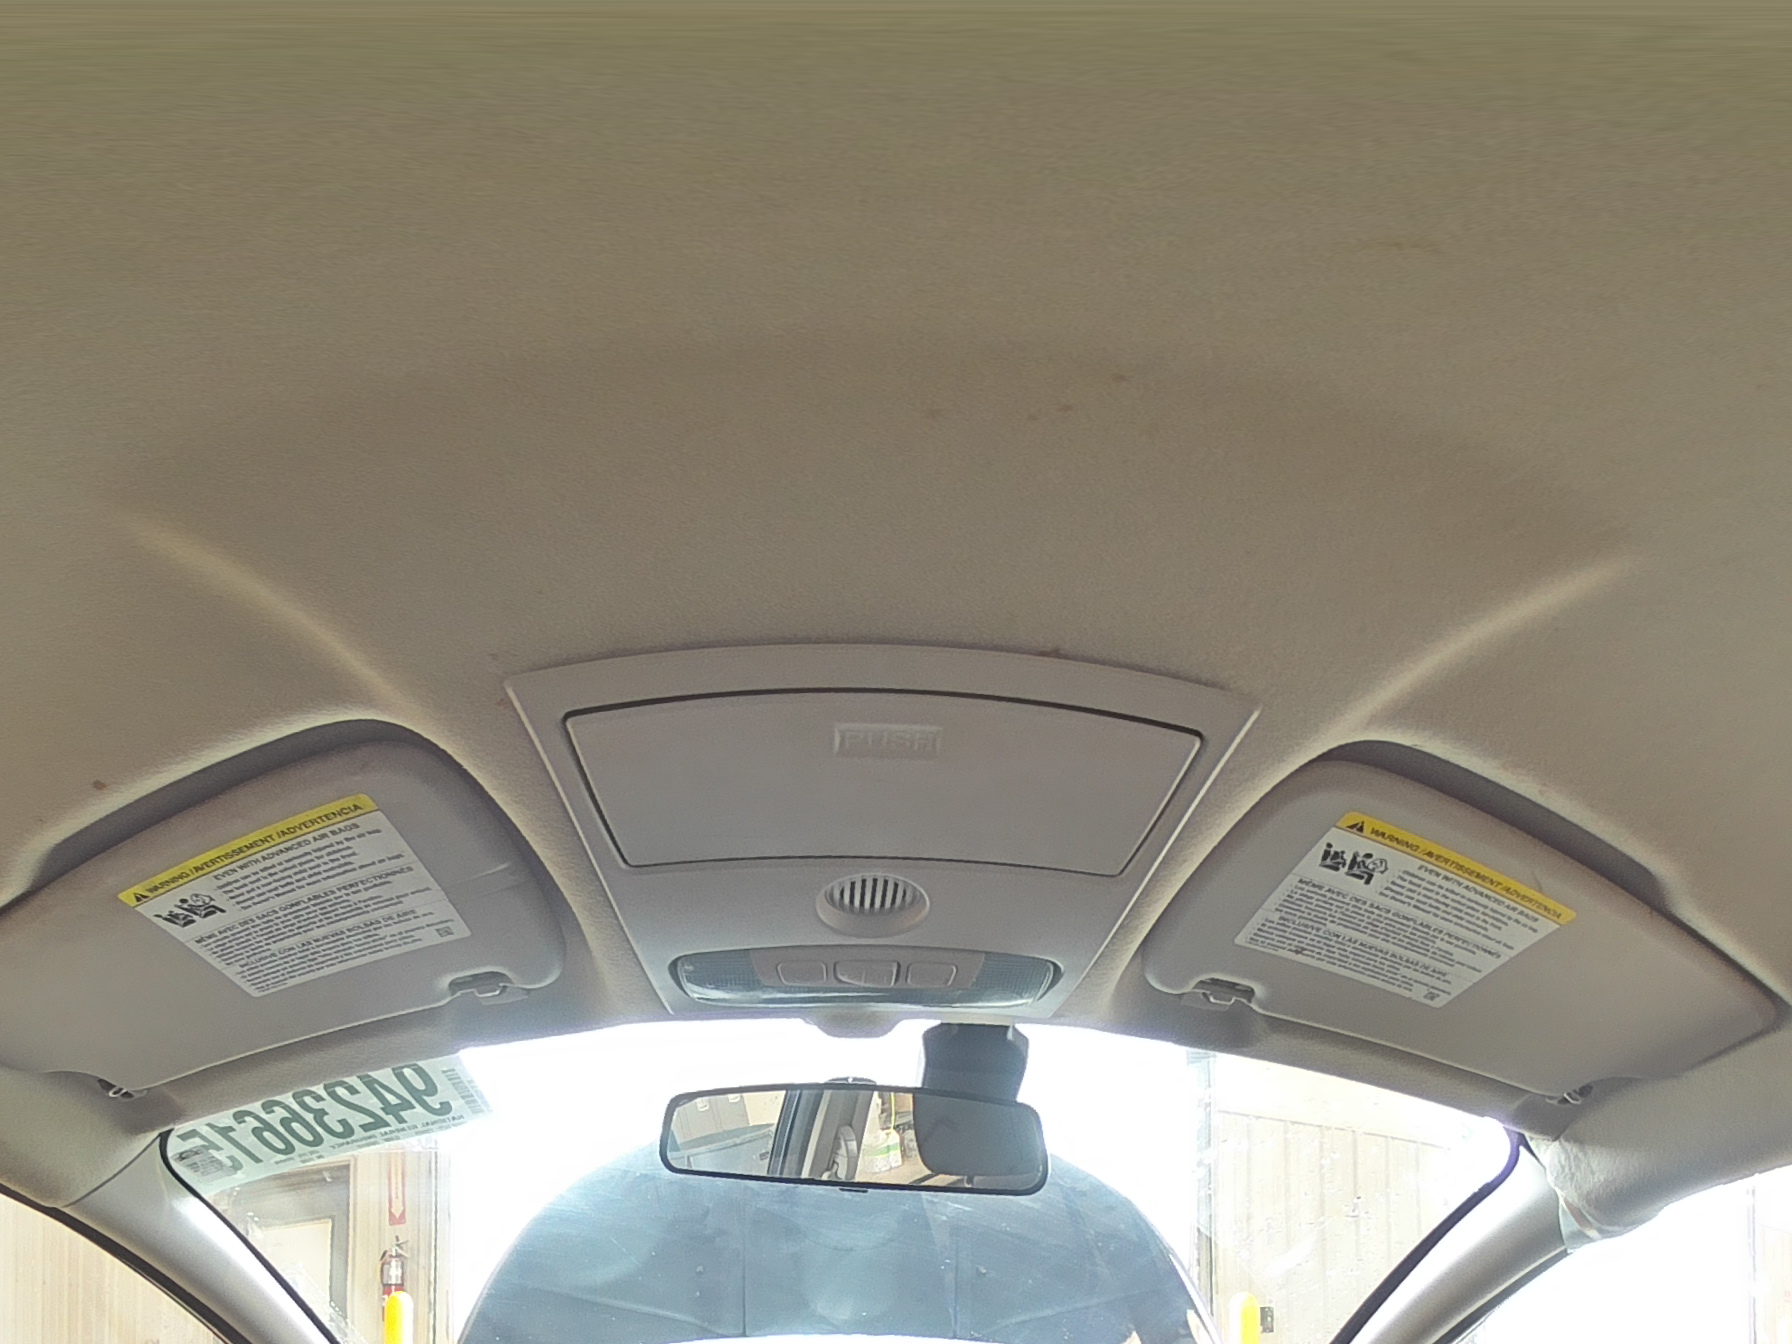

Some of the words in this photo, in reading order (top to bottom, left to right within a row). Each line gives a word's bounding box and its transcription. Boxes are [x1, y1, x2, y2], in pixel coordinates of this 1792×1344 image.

[844, 730, 934, 751] PUSH
[212, 867, 240, 881] EVEN
[235, 857, 263, 871] WITH
[259, 837, 313, 862] ADVANCED
[309, 830, 331, 843] AIR
[328, 819, 361, 838] BAGS
[1368, 824, 1422, 854] WARNING
[143, 869, 192, 893] WARNING
[215, 923, 241, 935] AVEC
[254, 908, 281, 921] SACS
